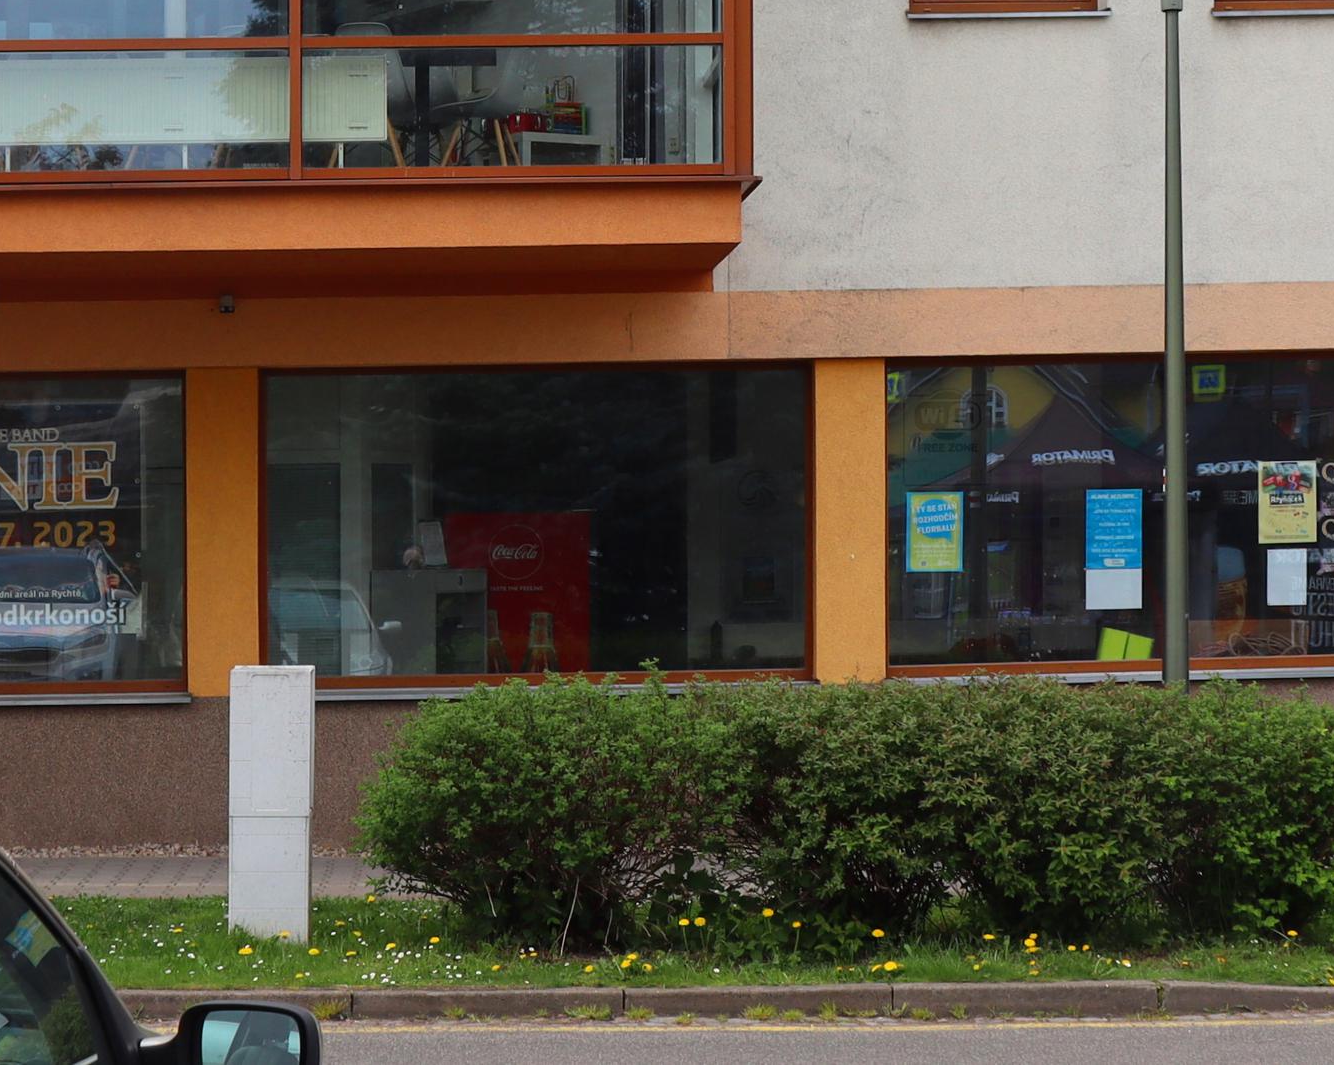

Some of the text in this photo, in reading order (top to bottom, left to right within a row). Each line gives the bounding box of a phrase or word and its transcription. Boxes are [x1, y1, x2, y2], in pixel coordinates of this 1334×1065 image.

[11, 427, 60, 443] BAND
[947, 442, 979, 453] ZONE
[33, 520, 117, 549] 2023
[14, 589, 37, 599] areál
[39, 591, 50, 599] na
[51, 589, 82, 600] Rychtě
